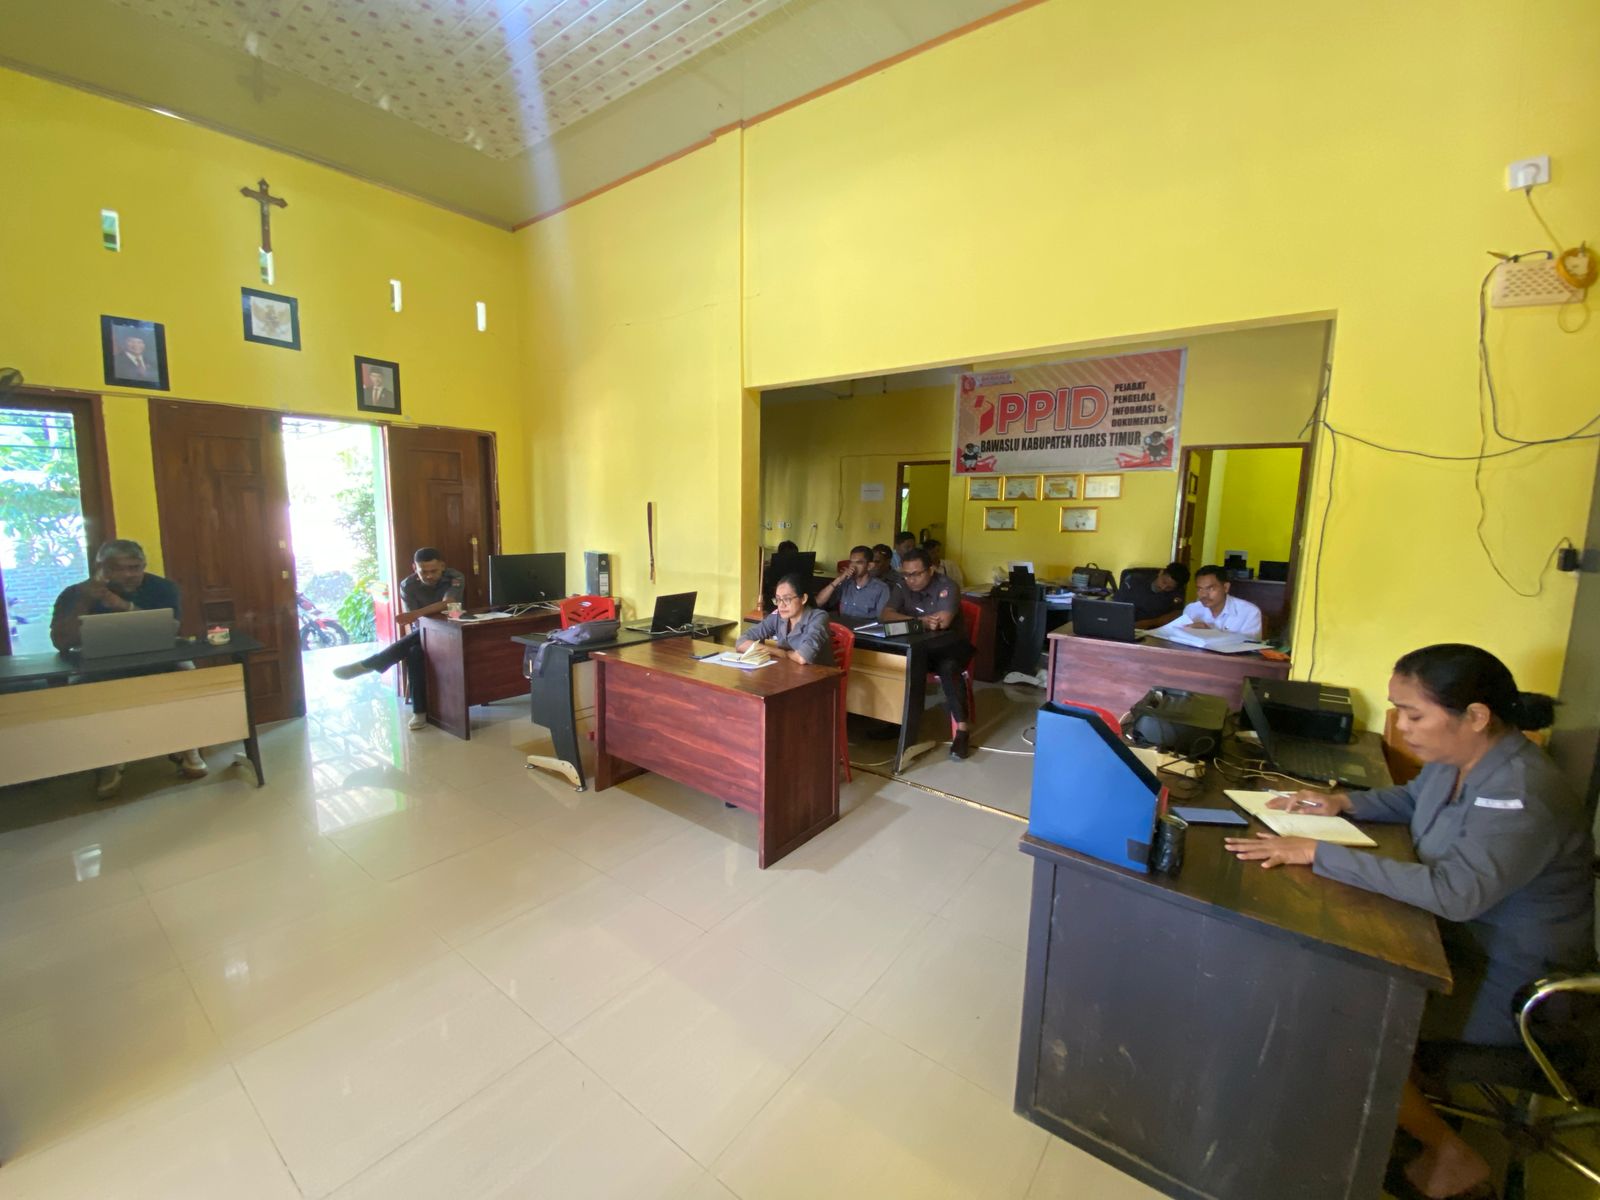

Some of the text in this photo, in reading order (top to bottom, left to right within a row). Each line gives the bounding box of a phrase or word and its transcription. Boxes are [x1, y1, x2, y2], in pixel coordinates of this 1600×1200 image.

[1114, 381, 1147, 392] PEJABAT
[1113, 393, 1156, 404] PENGELOLA
[997, 385, 1109, 435] PPID
[1112, 404, 1156, 416] INFORMASI
[1111, 415, 1168, 427] DOKUMENTASI
[980, 431, 1141, 453] BAWASLU KABUPATEN FLORES TIMUR
